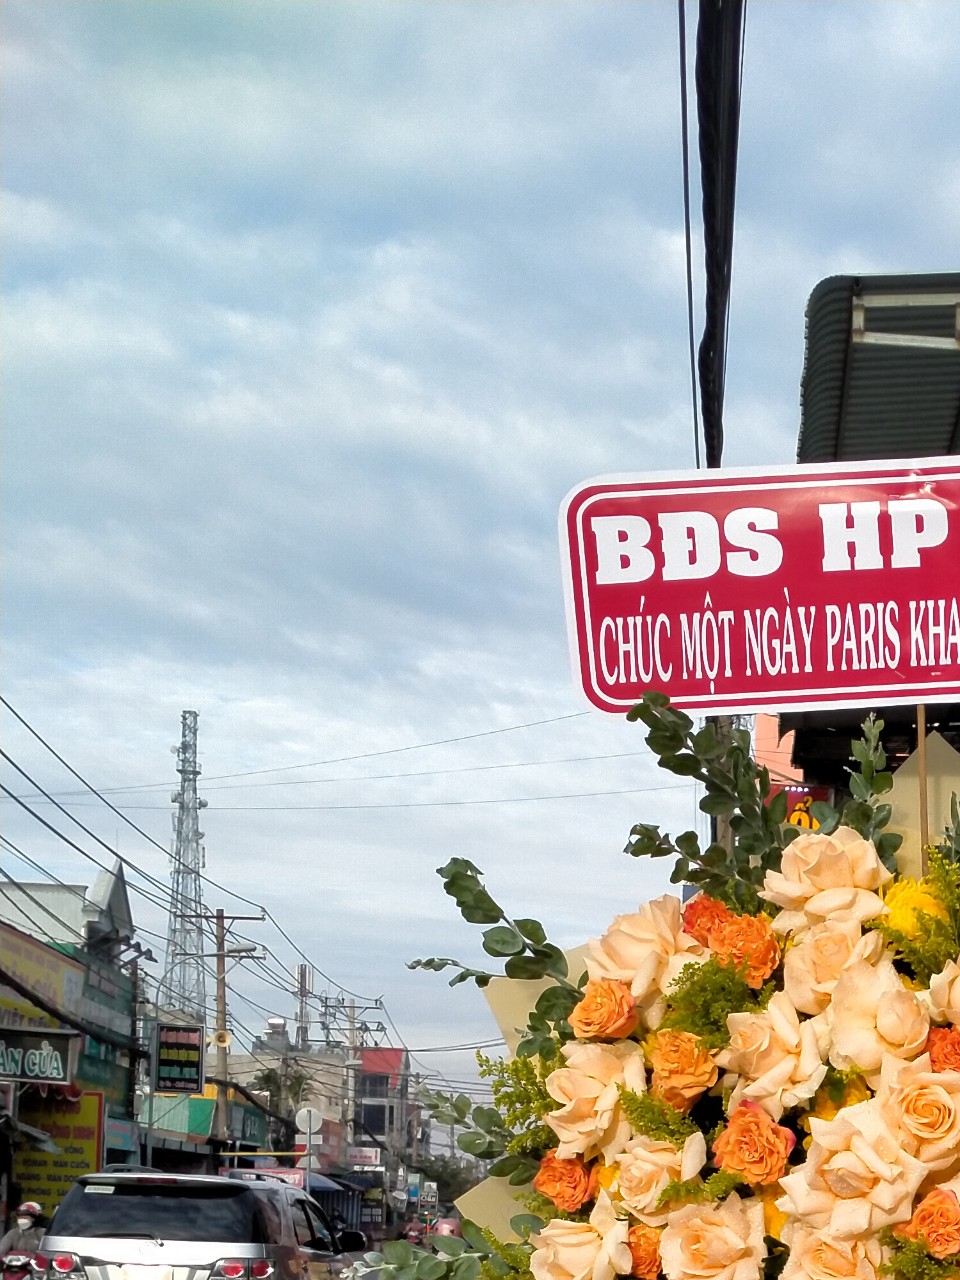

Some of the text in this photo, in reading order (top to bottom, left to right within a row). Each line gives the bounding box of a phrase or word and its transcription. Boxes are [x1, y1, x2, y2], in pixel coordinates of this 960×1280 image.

[590, 508, 784, 586] BĐS
[818, 497, 950, 573] HP
[599, 593, 673, 688] CHÚC
[681, 593, 737, 695] MỘT
[744, 588, 817, 676] NGÀY
[824, 600, 902, 671] PARIS
